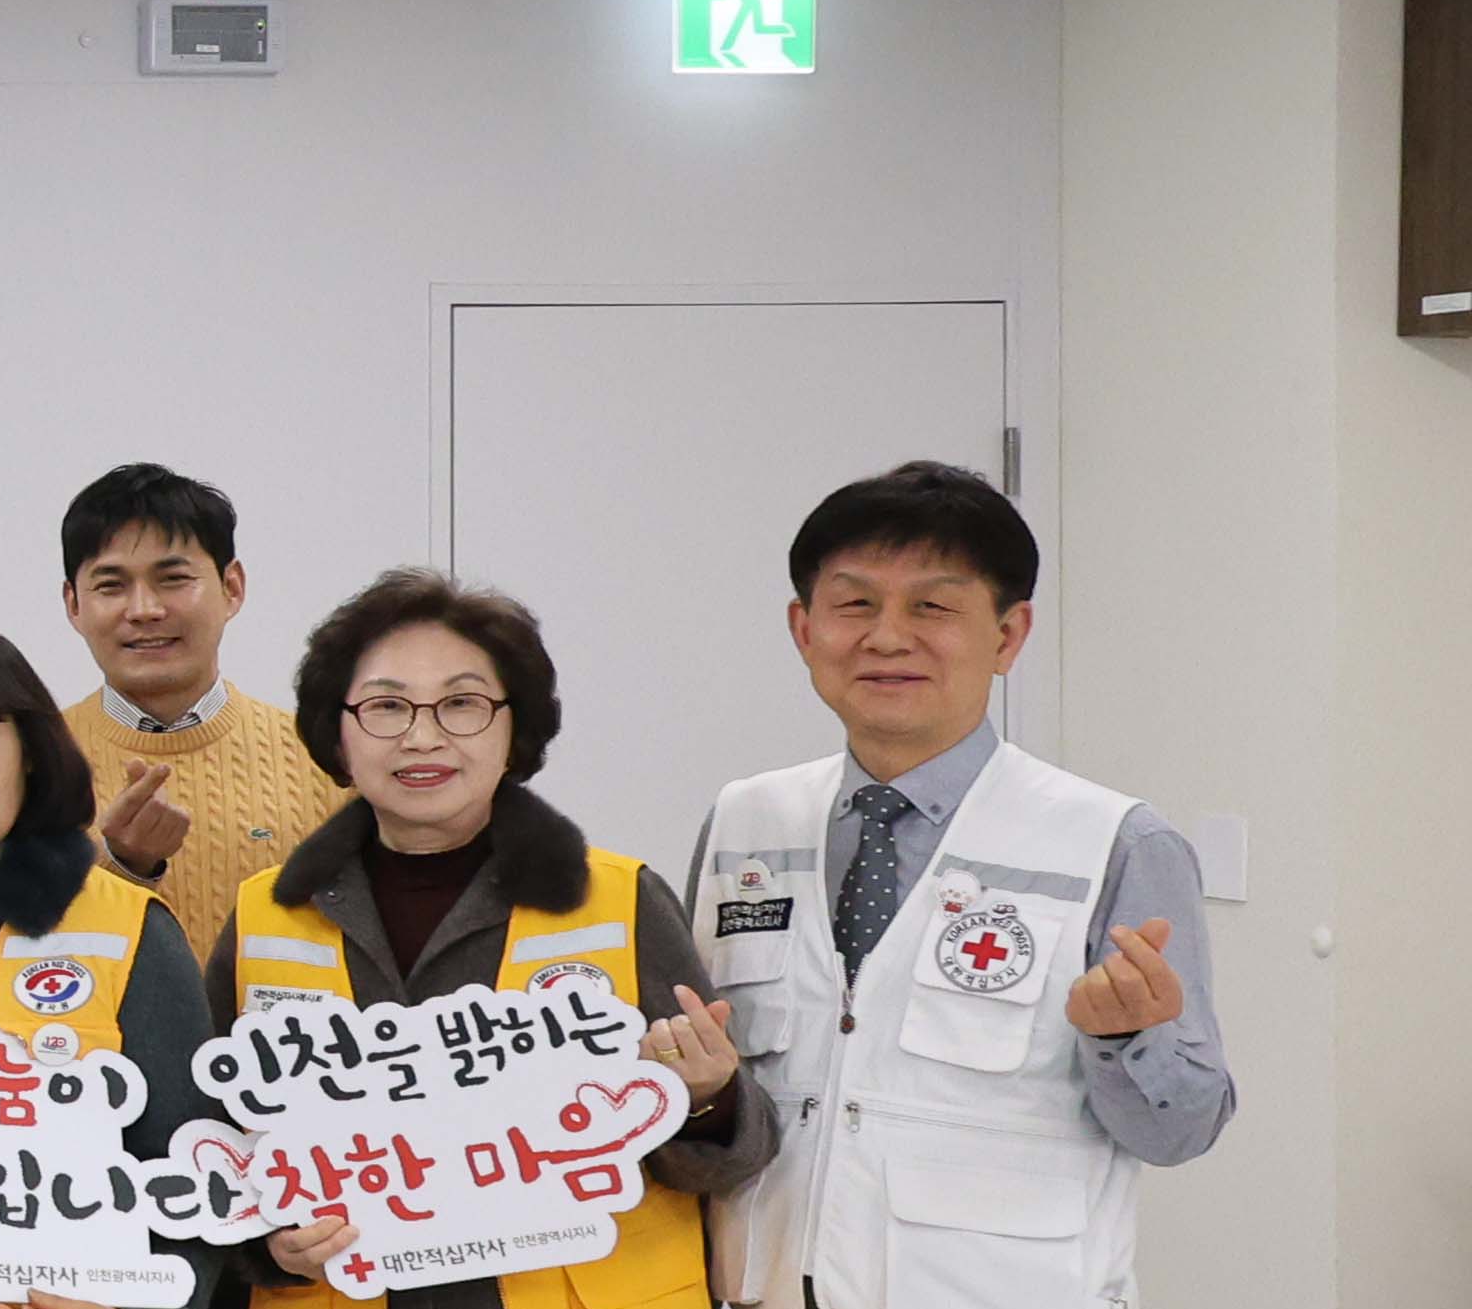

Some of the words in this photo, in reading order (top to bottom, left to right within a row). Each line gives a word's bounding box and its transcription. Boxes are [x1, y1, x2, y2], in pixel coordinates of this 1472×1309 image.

[945, 916, 986, 943] KOREAN
[1011, 926, 1030, 956] CROSS
[209, 1014, 426, 1114] 인천을
[436, 991, 626, 1086] 밝히는
[266, 1133, 435, 1223] 착한
[464, 1087, 652, 1201] 마음
[381, 1237, 509, 1276] 대한적십자사
[512, 1223, 598, 1249] 인천광역시지사
[85, 1268, 177, 1285] 인천광역시지사
